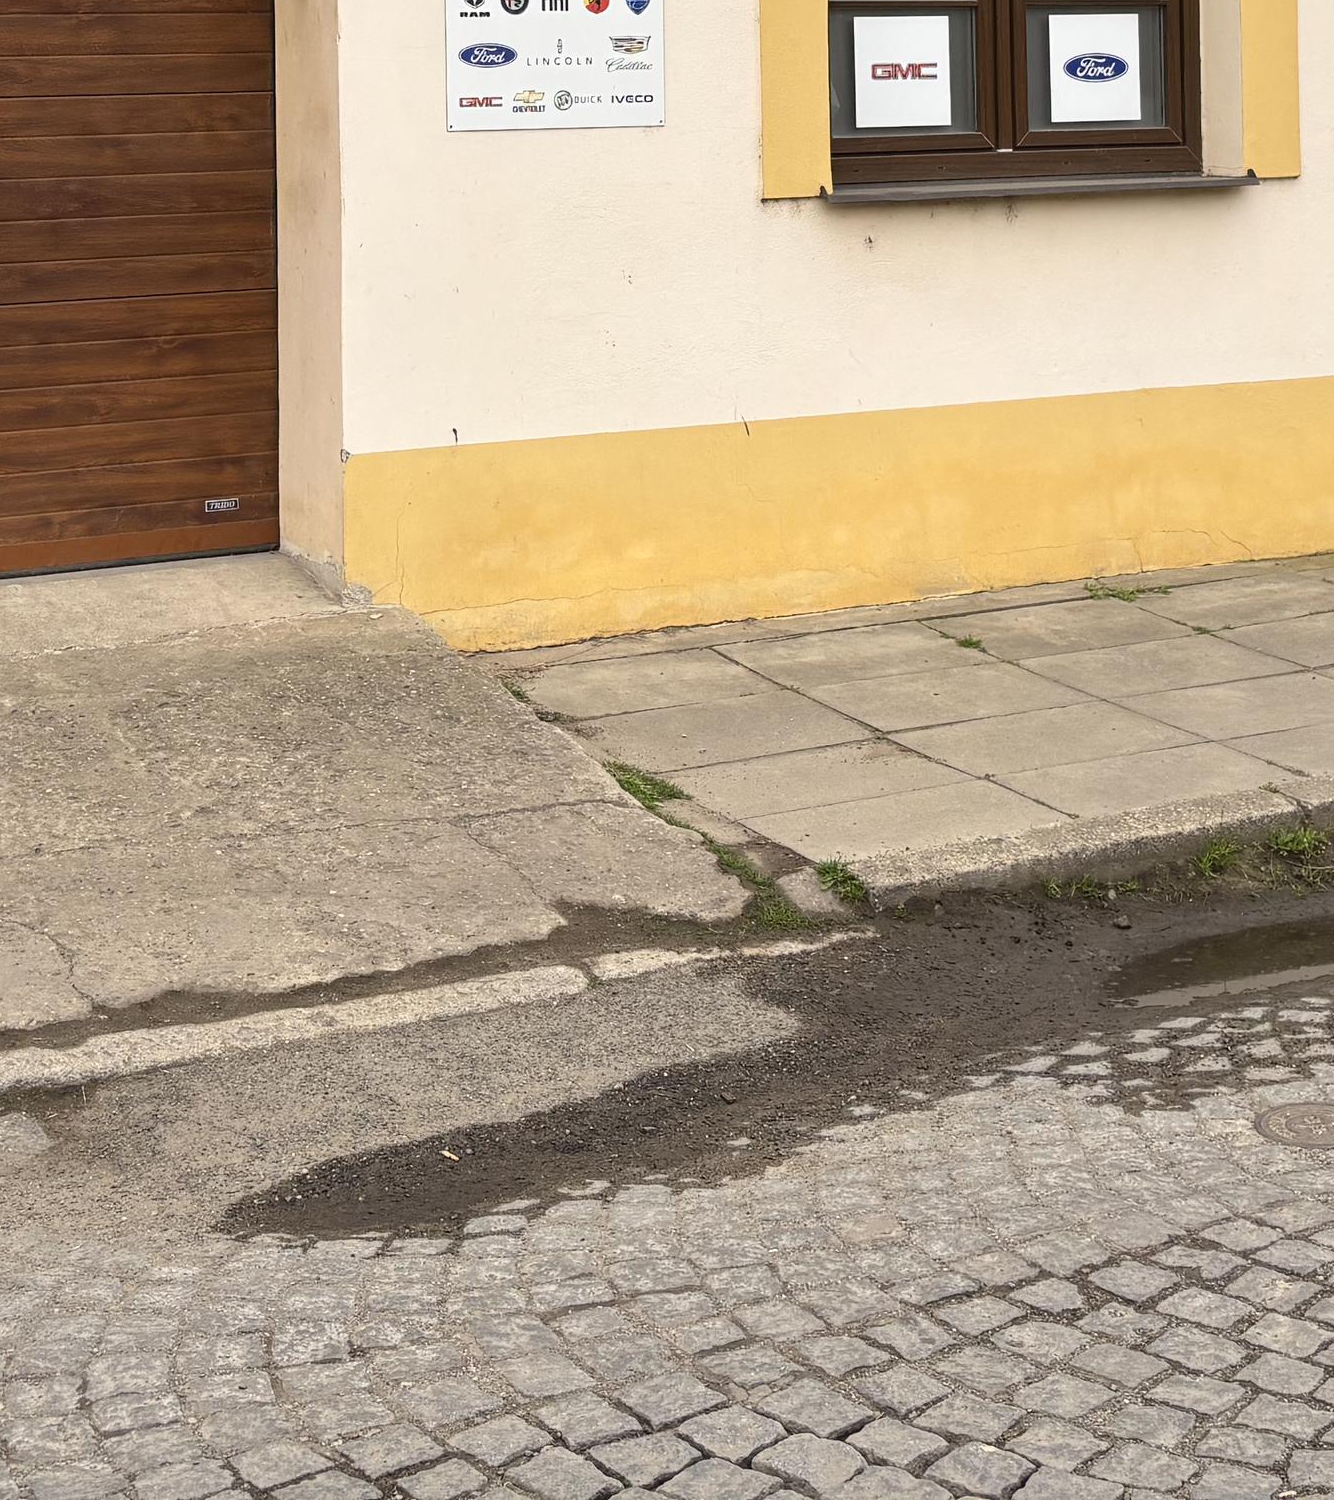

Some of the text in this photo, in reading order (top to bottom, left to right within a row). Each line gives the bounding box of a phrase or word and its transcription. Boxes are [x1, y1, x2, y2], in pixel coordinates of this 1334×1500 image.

[470, 47, 506, 64] Ford
[526, 56, 593, 67] LINCOLN
[871, 62, 938, 81] GMC
[1076, 57, 1116, 78] Ford
[458, 96, 504, 108] GMC
[573, 95, 603, 104] BUICK
[610, 94, 655, 104] IVECO
